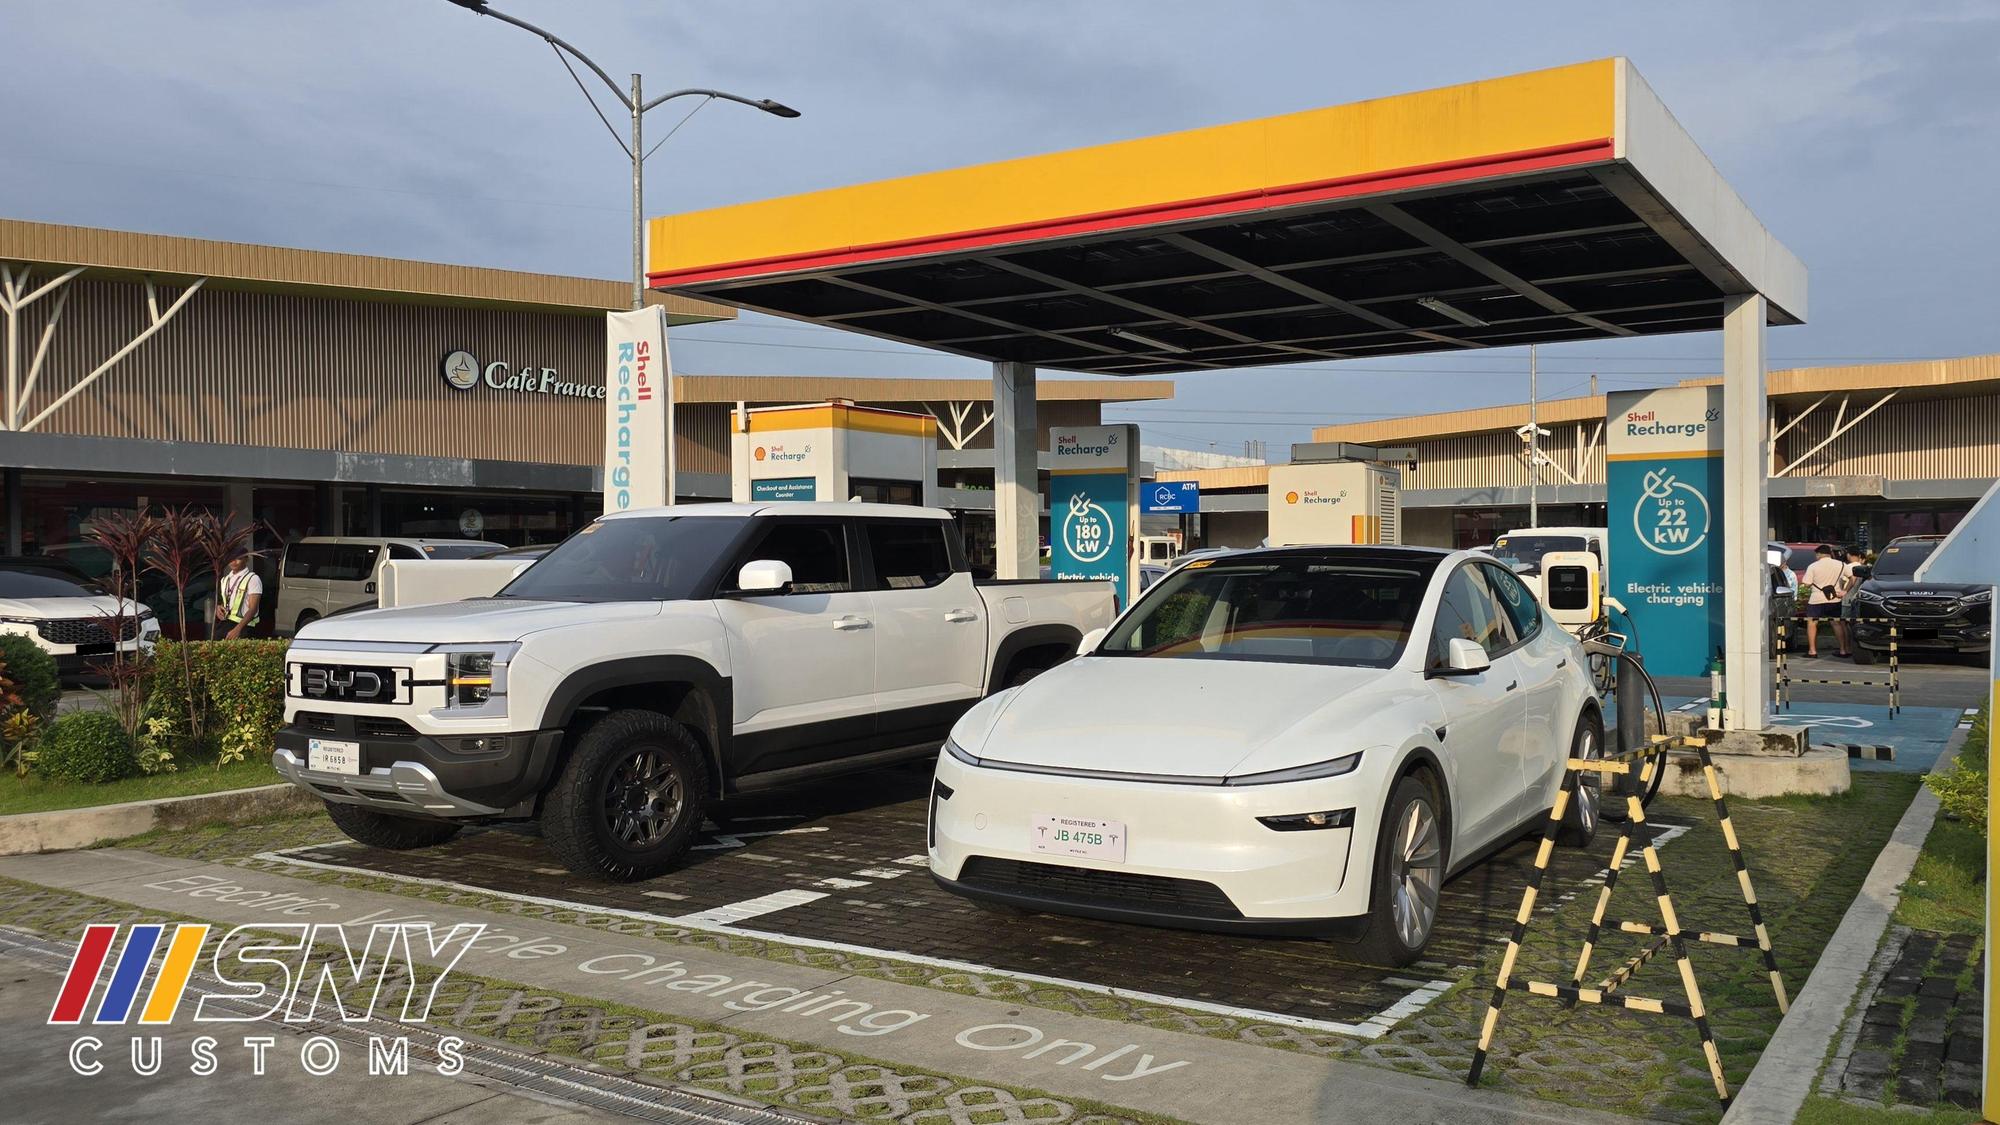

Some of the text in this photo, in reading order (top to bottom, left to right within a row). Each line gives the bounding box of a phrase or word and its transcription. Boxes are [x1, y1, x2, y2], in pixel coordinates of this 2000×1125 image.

[637, 341, 652, 400] Shell
[1627, 411, 1655, 422] Shell
[612, 342, 636, 509] Recharge
[1627, 421, 1706, 437] Recharge
[1058, 436, 1077, 444] Shell
[1058, 444, 1109, 456] Recharge
[771, 452, 806, 462] Recharge
[1304, 496, 1341, 505] Recharge
[1658, 498, 1685, 507] Up to
[1079, 516, 1088, 524] Up
[1657, 508, 1687, 526] 22
[1075, 525, 1101, 539] 180
[1654, 528, 1690, 543] kW
[1076, 540, 1099, 553] kW
[1627, 582, 1723, 594] Electric vehicle
[1646, 593, 1704, 606] charging
[307, 668, 381, 697] BYD
[1060, 819, 1096, 828] REGISTERED
[1054, 829, 1103, 845] JB 475B
[143, 875, 1191, 1081] Electric Vehicle Charging Only
